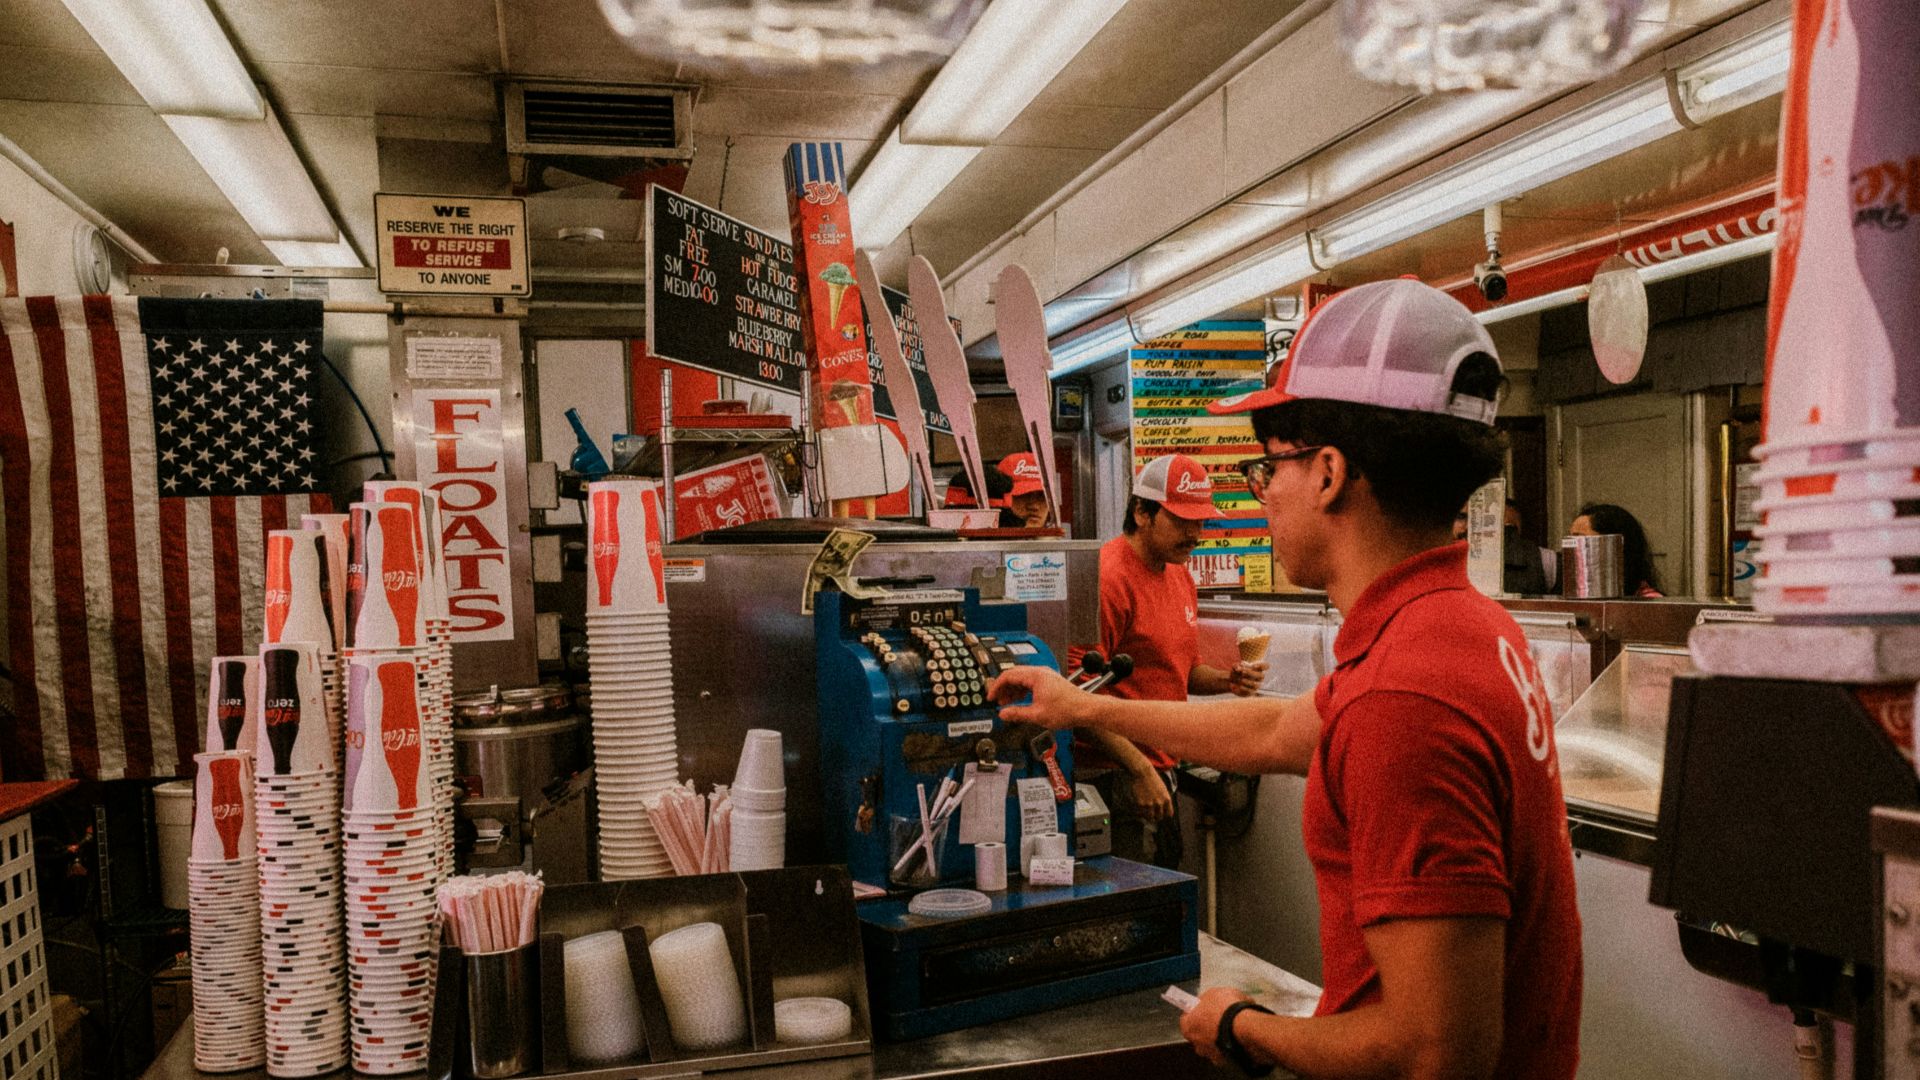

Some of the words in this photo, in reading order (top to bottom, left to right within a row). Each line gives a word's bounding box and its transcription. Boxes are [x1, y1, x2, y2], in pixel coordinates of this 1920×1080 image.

[803, 181, 840, 206] Joy
[432, 205, 471, 218] WE
[386, 220, 446, 235] RESERVE
[449, 222, 474, 235] THE
[478, 223, 516, 236] RIGHT
[667, 196, 699, 224] SOFT
[701, 211, 740, 242] SERVE
[744, 229, 794, 264] SUNDAES
[685, 223, 705, 247] FAT
[410, 239, 431, 251] TO
[436, 241, 495, 254] REFUSE
[679, 239, 710, 266] FREE
[425, 254, 483, 267] SERVICE
[664, 254, 682, 277] SM
[691, 263, 717, 288] 7.00
[741, 255, 761, 279] HOT
[767, 266, 798, 293] FUDGE
[418, 272, 435, 284] TO
[440, 273, 492, 286] ANYONE
[664, 273, 690, 298] MED
[689, 281, 719, 305] 10.00
[746, 277, 797, 310] CARAMEL
[737, 316, 793, 349] BLUEBERRY
[821, 352, 864, 369] CONES
[1144, 361, 1166, 369] RUM
[1171, 360, 1204, 369] RAISIN
[1145, 370, 1189, 378] CHOCOLATE
[1143, 379, 1191, 388] CHOCOLATE
[1146, 399, 1182, 407] BUTTER
[1141, 418, 1188, 427] CHOCOLATE
[1143, 427, 1170, 436] COFFEE
[1172, 427, 1192, 435] CHIP
[1141, 437, 1166, 445] WHITE
[1170, 436, 1211, 445] CHOCOLATE
[428, 399, 508, 632] FLOATS
[1186, 555, 1239, 571] PRINKLES
[219, 698, 242, 706] zero
[267, 698, 294, 708] zero
